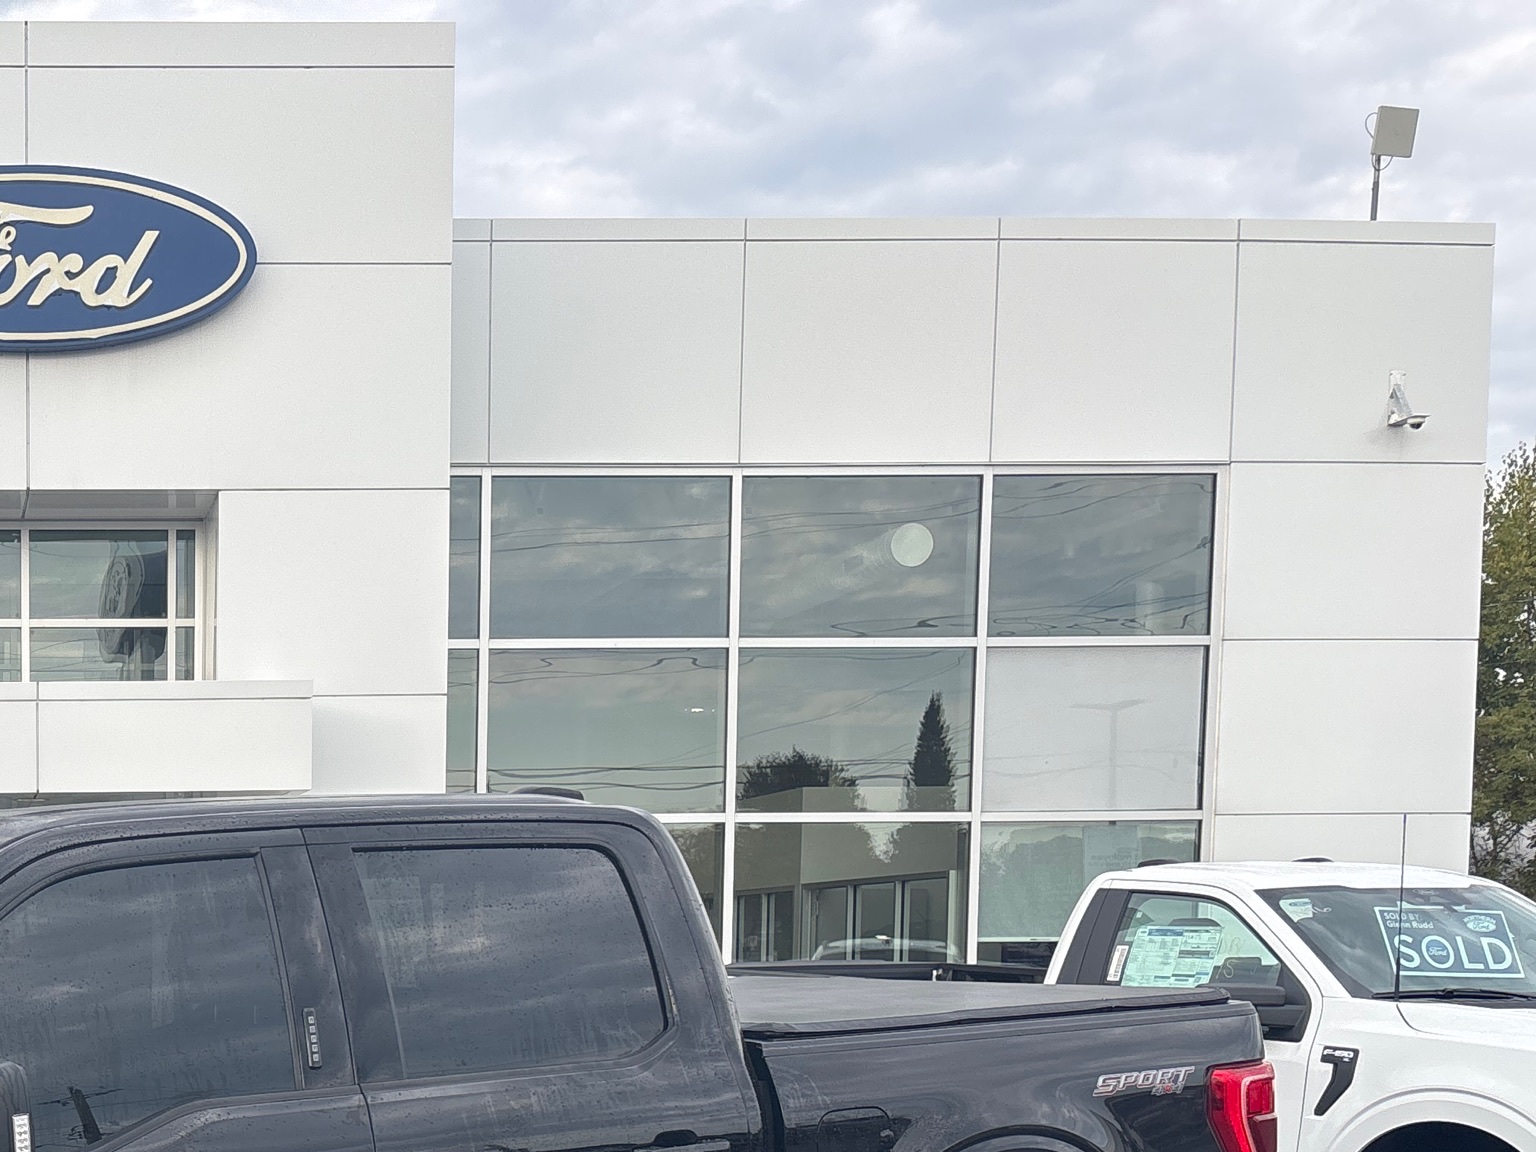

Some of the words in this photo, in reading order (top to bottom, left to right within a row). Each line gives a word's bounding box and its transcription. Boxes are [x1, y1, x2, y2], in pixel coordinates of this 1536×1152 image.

[1383, 912, 1407, 920] SOLD
[1462, 914, 1497, 925] NORTHERN
[1386, 920, 1411, 929] Glenn
[1411, 921, 1434, 929] Rudd
[1393, 934, 1513, 970] SOLD
[1428, 947, 1448, 956] Ford
[1092, 1065, 1196, 1097] SPORT
